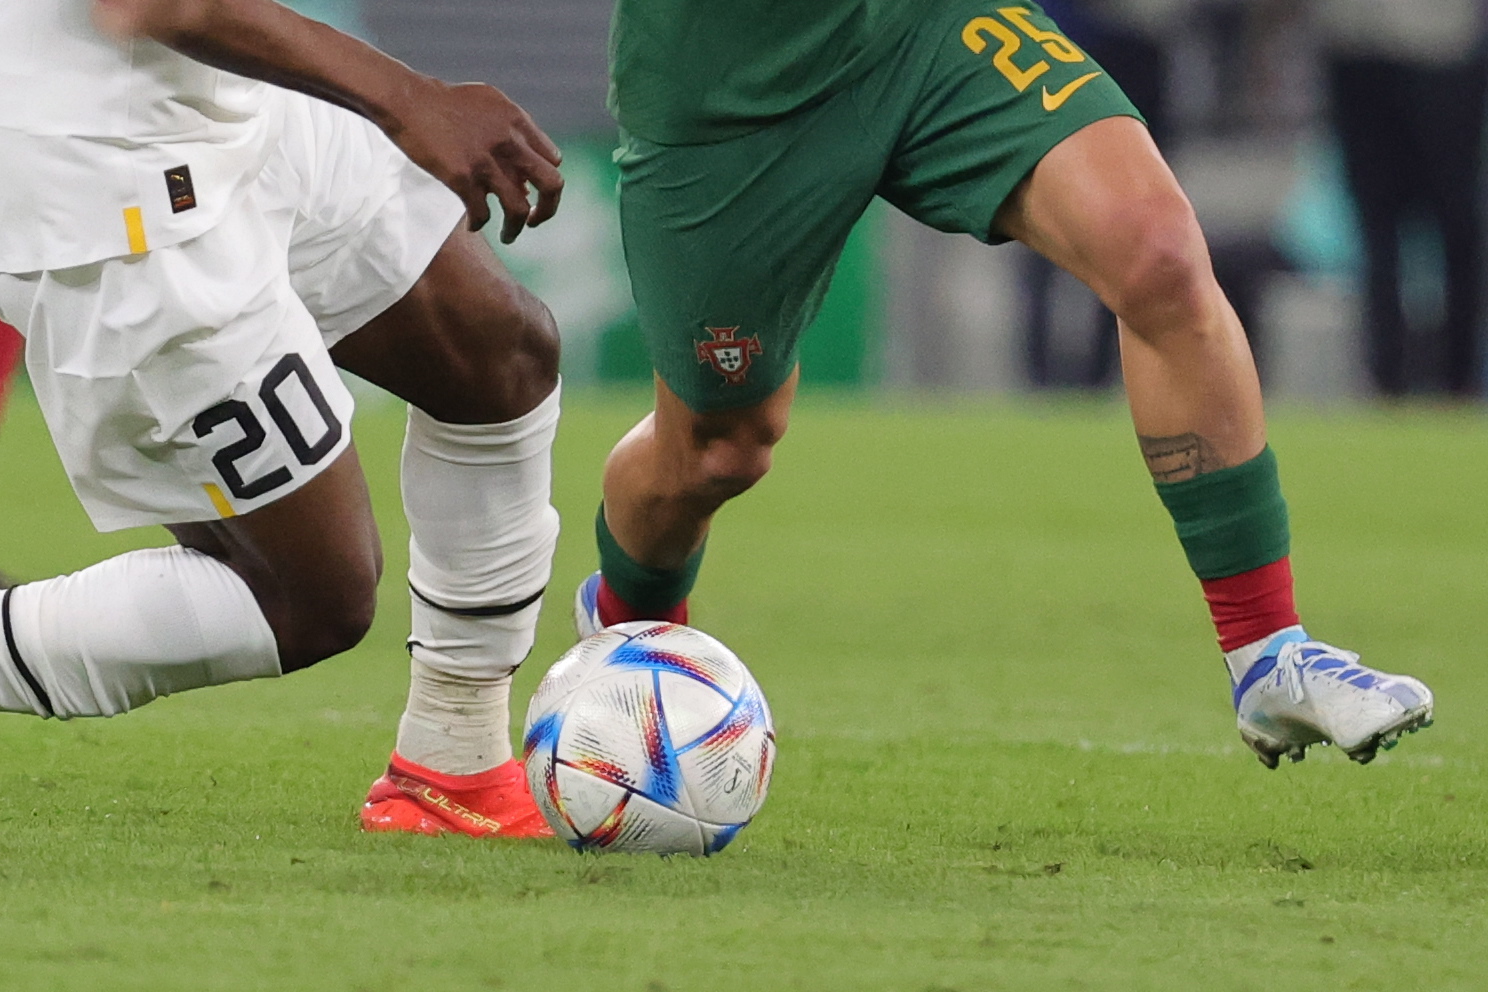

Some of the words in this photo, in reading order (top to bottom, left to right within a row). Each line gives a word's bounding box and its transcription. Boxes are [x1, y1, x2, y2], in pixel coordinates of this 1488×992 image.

[962, 6, 1086, 93] 25
[192, 352, 342, 500] 20
[423, 787, 501, 833] ULTRA
